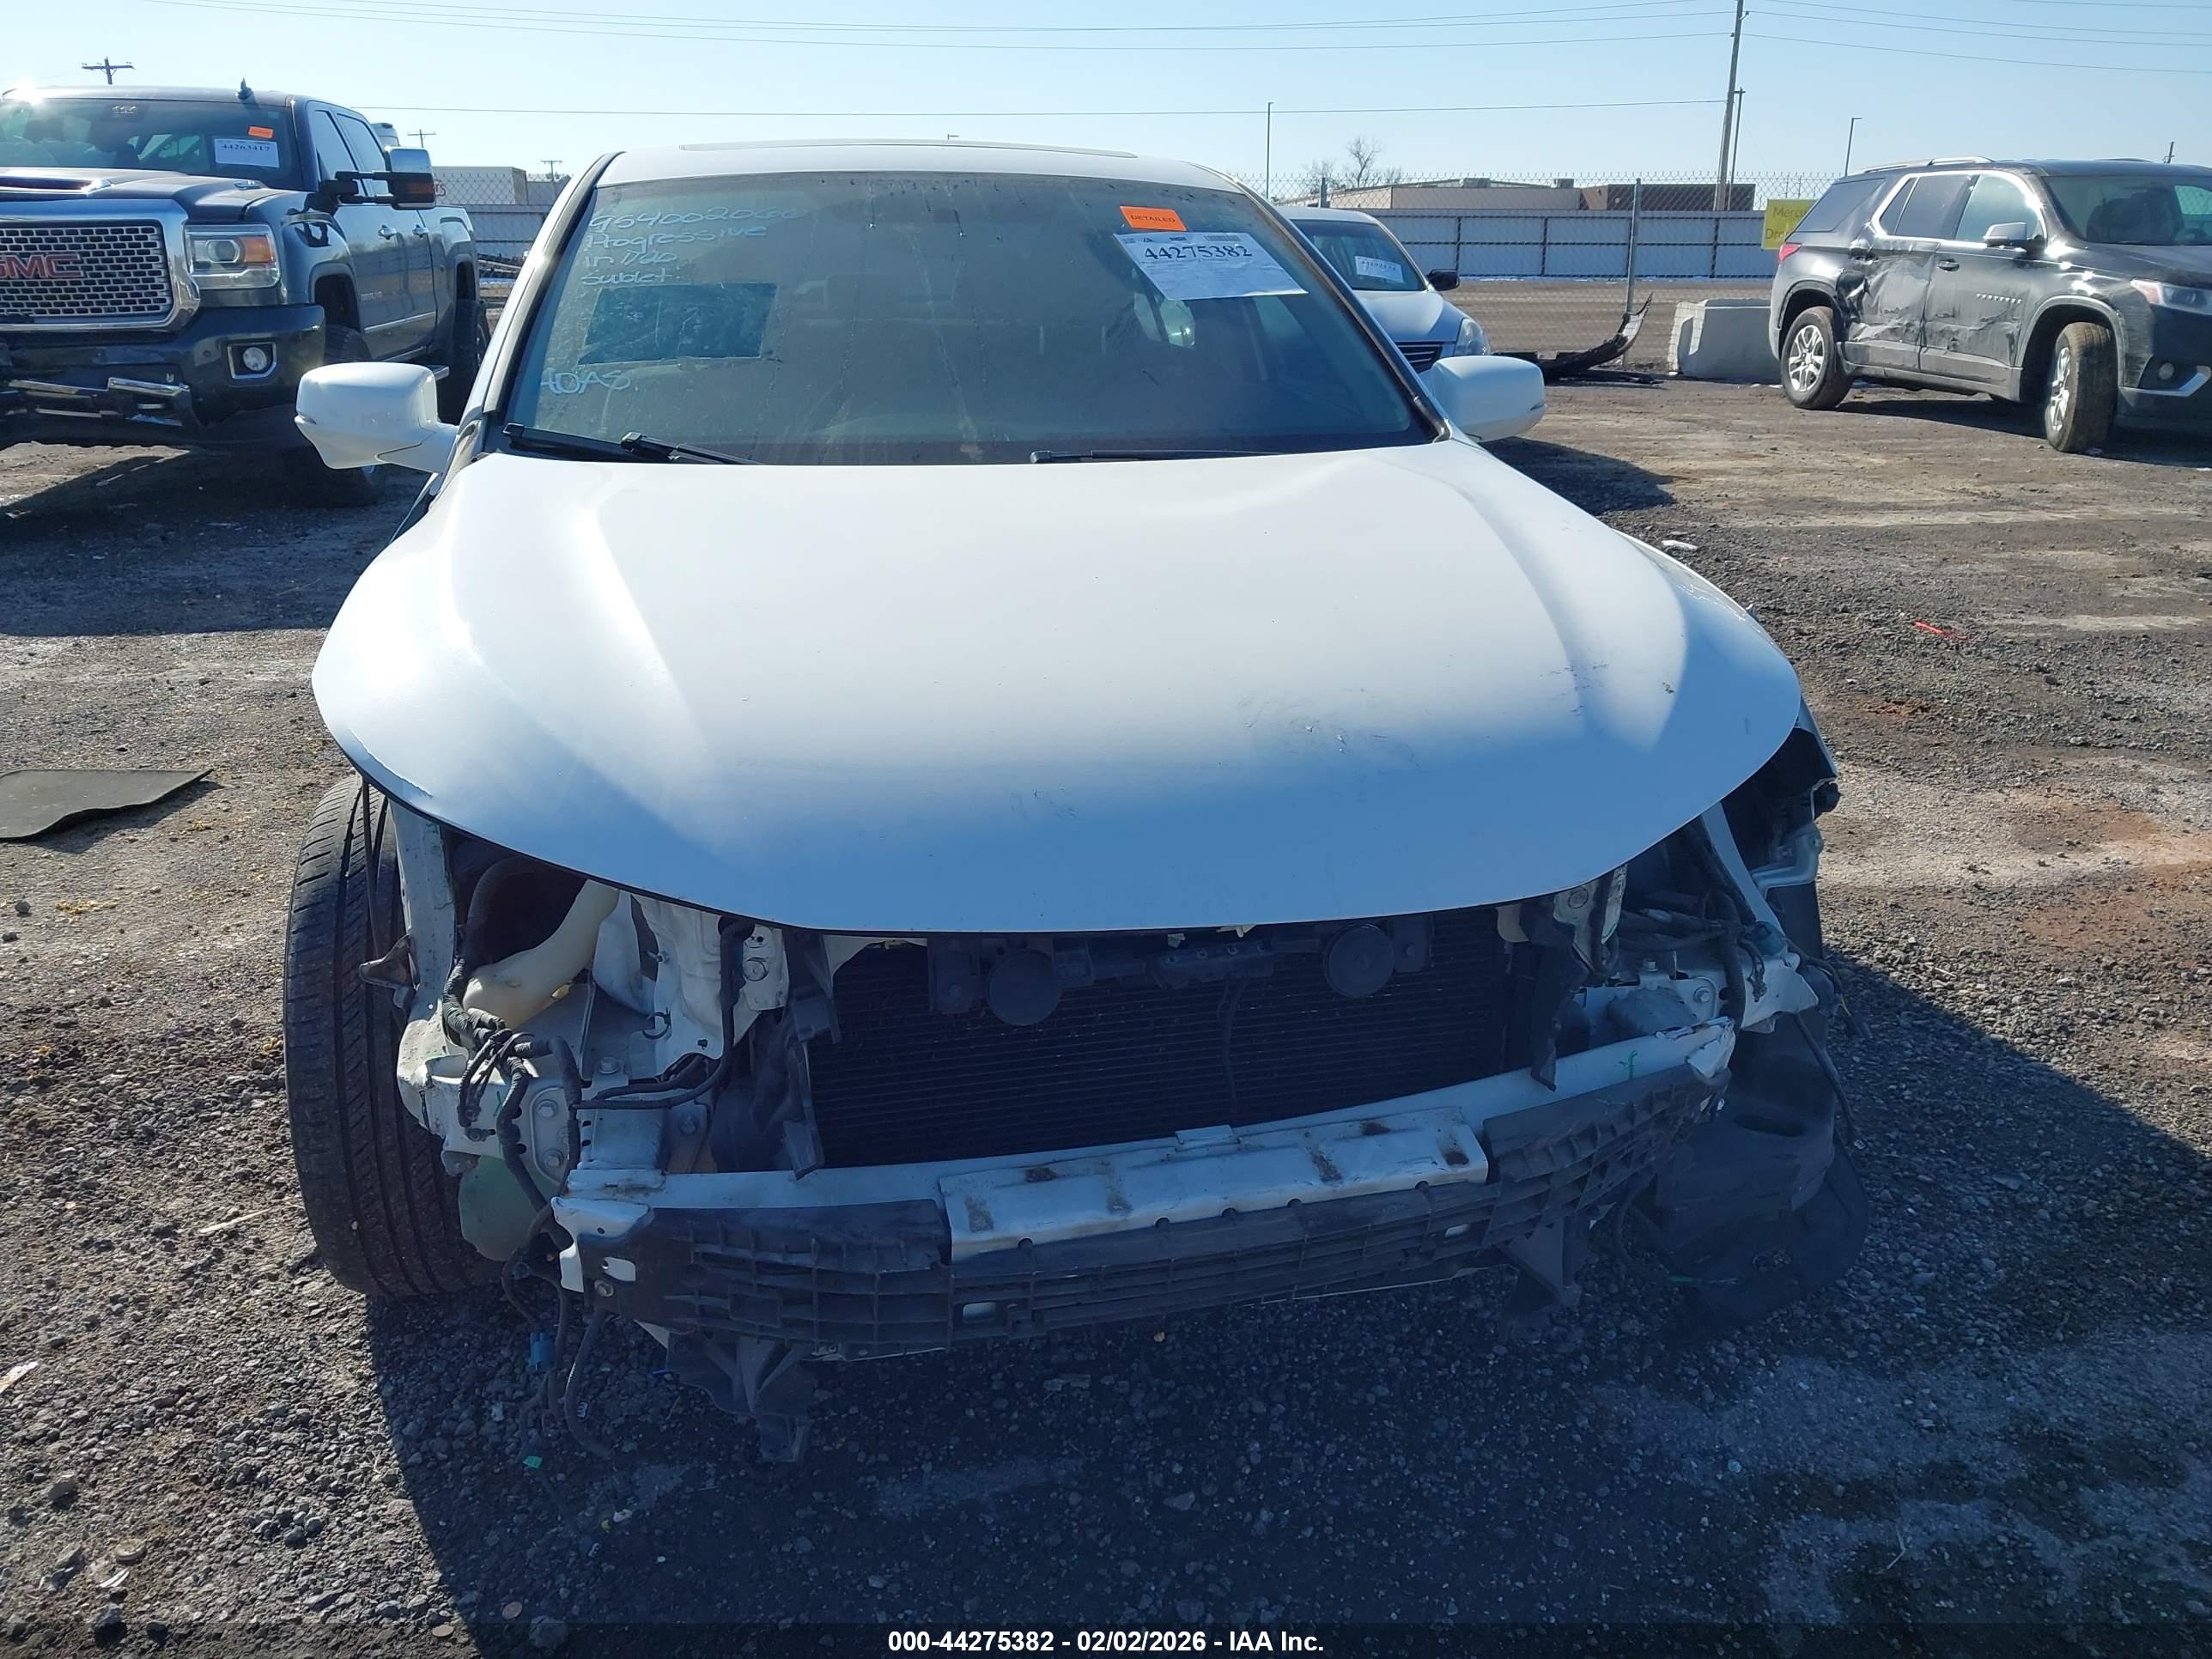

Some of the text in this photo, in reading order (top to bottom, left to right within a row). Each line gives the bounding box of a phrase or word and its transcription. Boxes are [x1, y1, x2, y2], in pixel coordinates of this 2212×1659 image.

[1130, 215, 1176, 223] DETAILED
[1145, 246, 1252, 259] 44275382
[0, 253, 83, 278] MC
